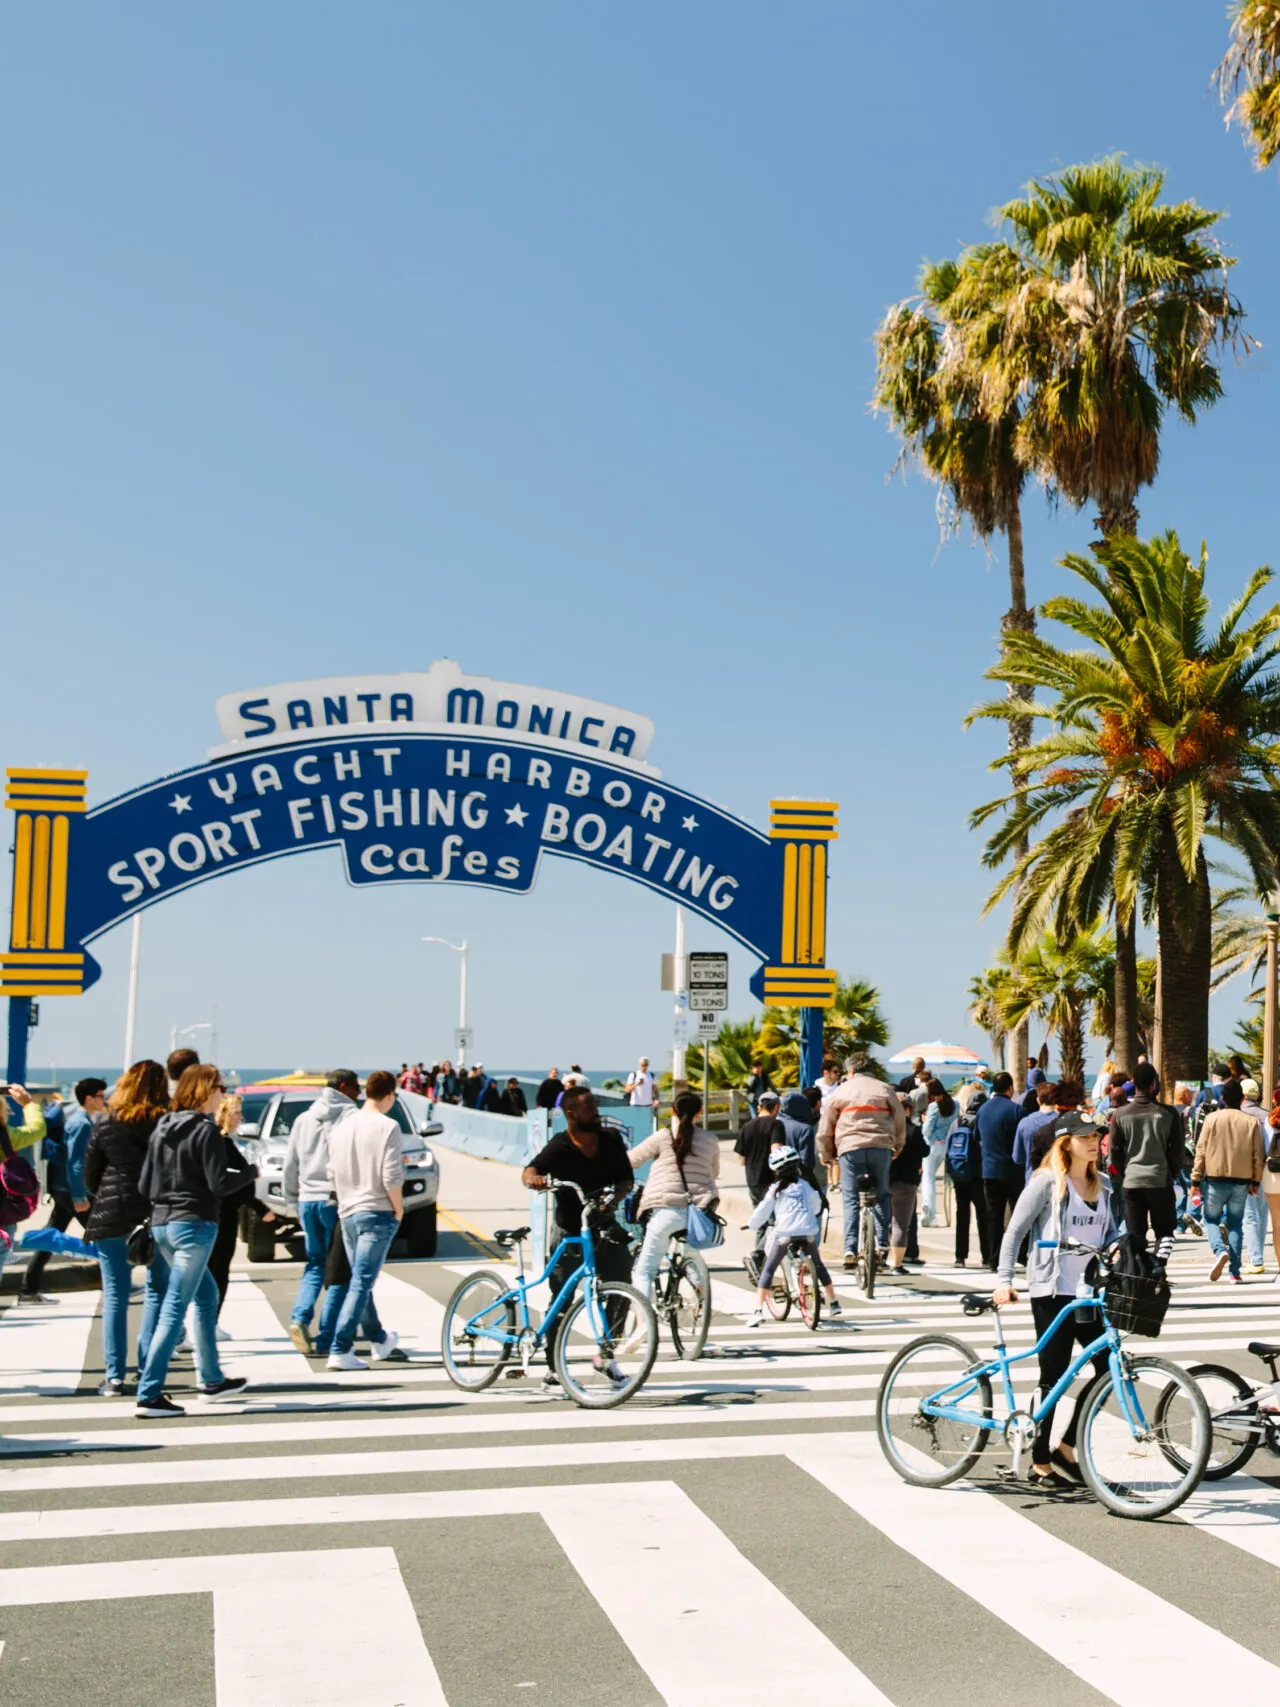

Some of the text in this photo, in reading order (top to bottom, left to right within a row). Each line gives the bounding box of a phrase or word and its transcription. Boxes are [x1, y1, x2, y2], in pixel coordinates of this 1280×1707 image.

[239, 687, 636, 757] SANTA MONICA
[208, 747, 666, 823] YACHT HARBOR
[107, 787, 740, 911] SPORT FISHING BOATING
[692, 971, 725, 979] 10 TONS
[702, 999, 724, 1007] TONS
[702, 1013, 714, 1022] NO
